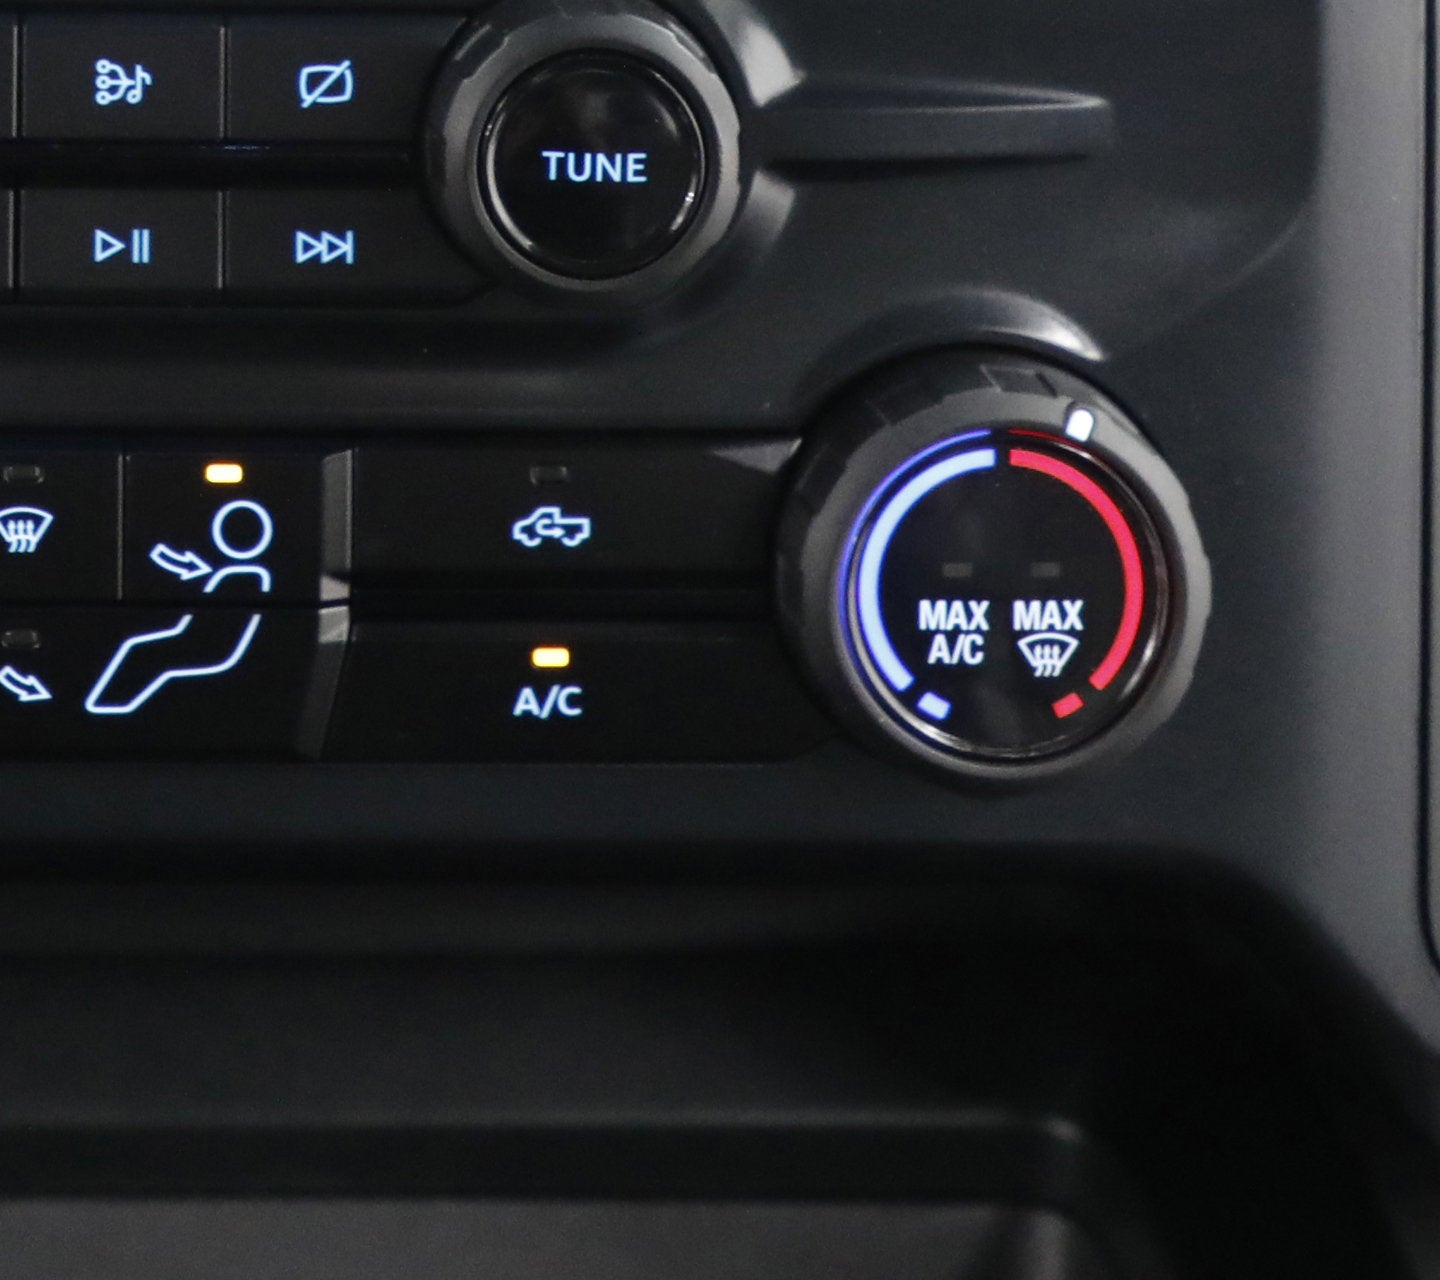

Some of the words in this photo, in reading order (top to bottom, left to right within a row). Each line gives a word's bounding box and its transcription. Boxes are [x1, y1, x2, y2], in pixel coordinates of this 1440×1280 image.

[542, 150, 648, 182] TUNE
[919, 601, 988, 631] MAX
[1013, 601, 1083, 631] MAX
[928, 634, 984, 665] A/C
[514, 687, 582, 716] A/C
